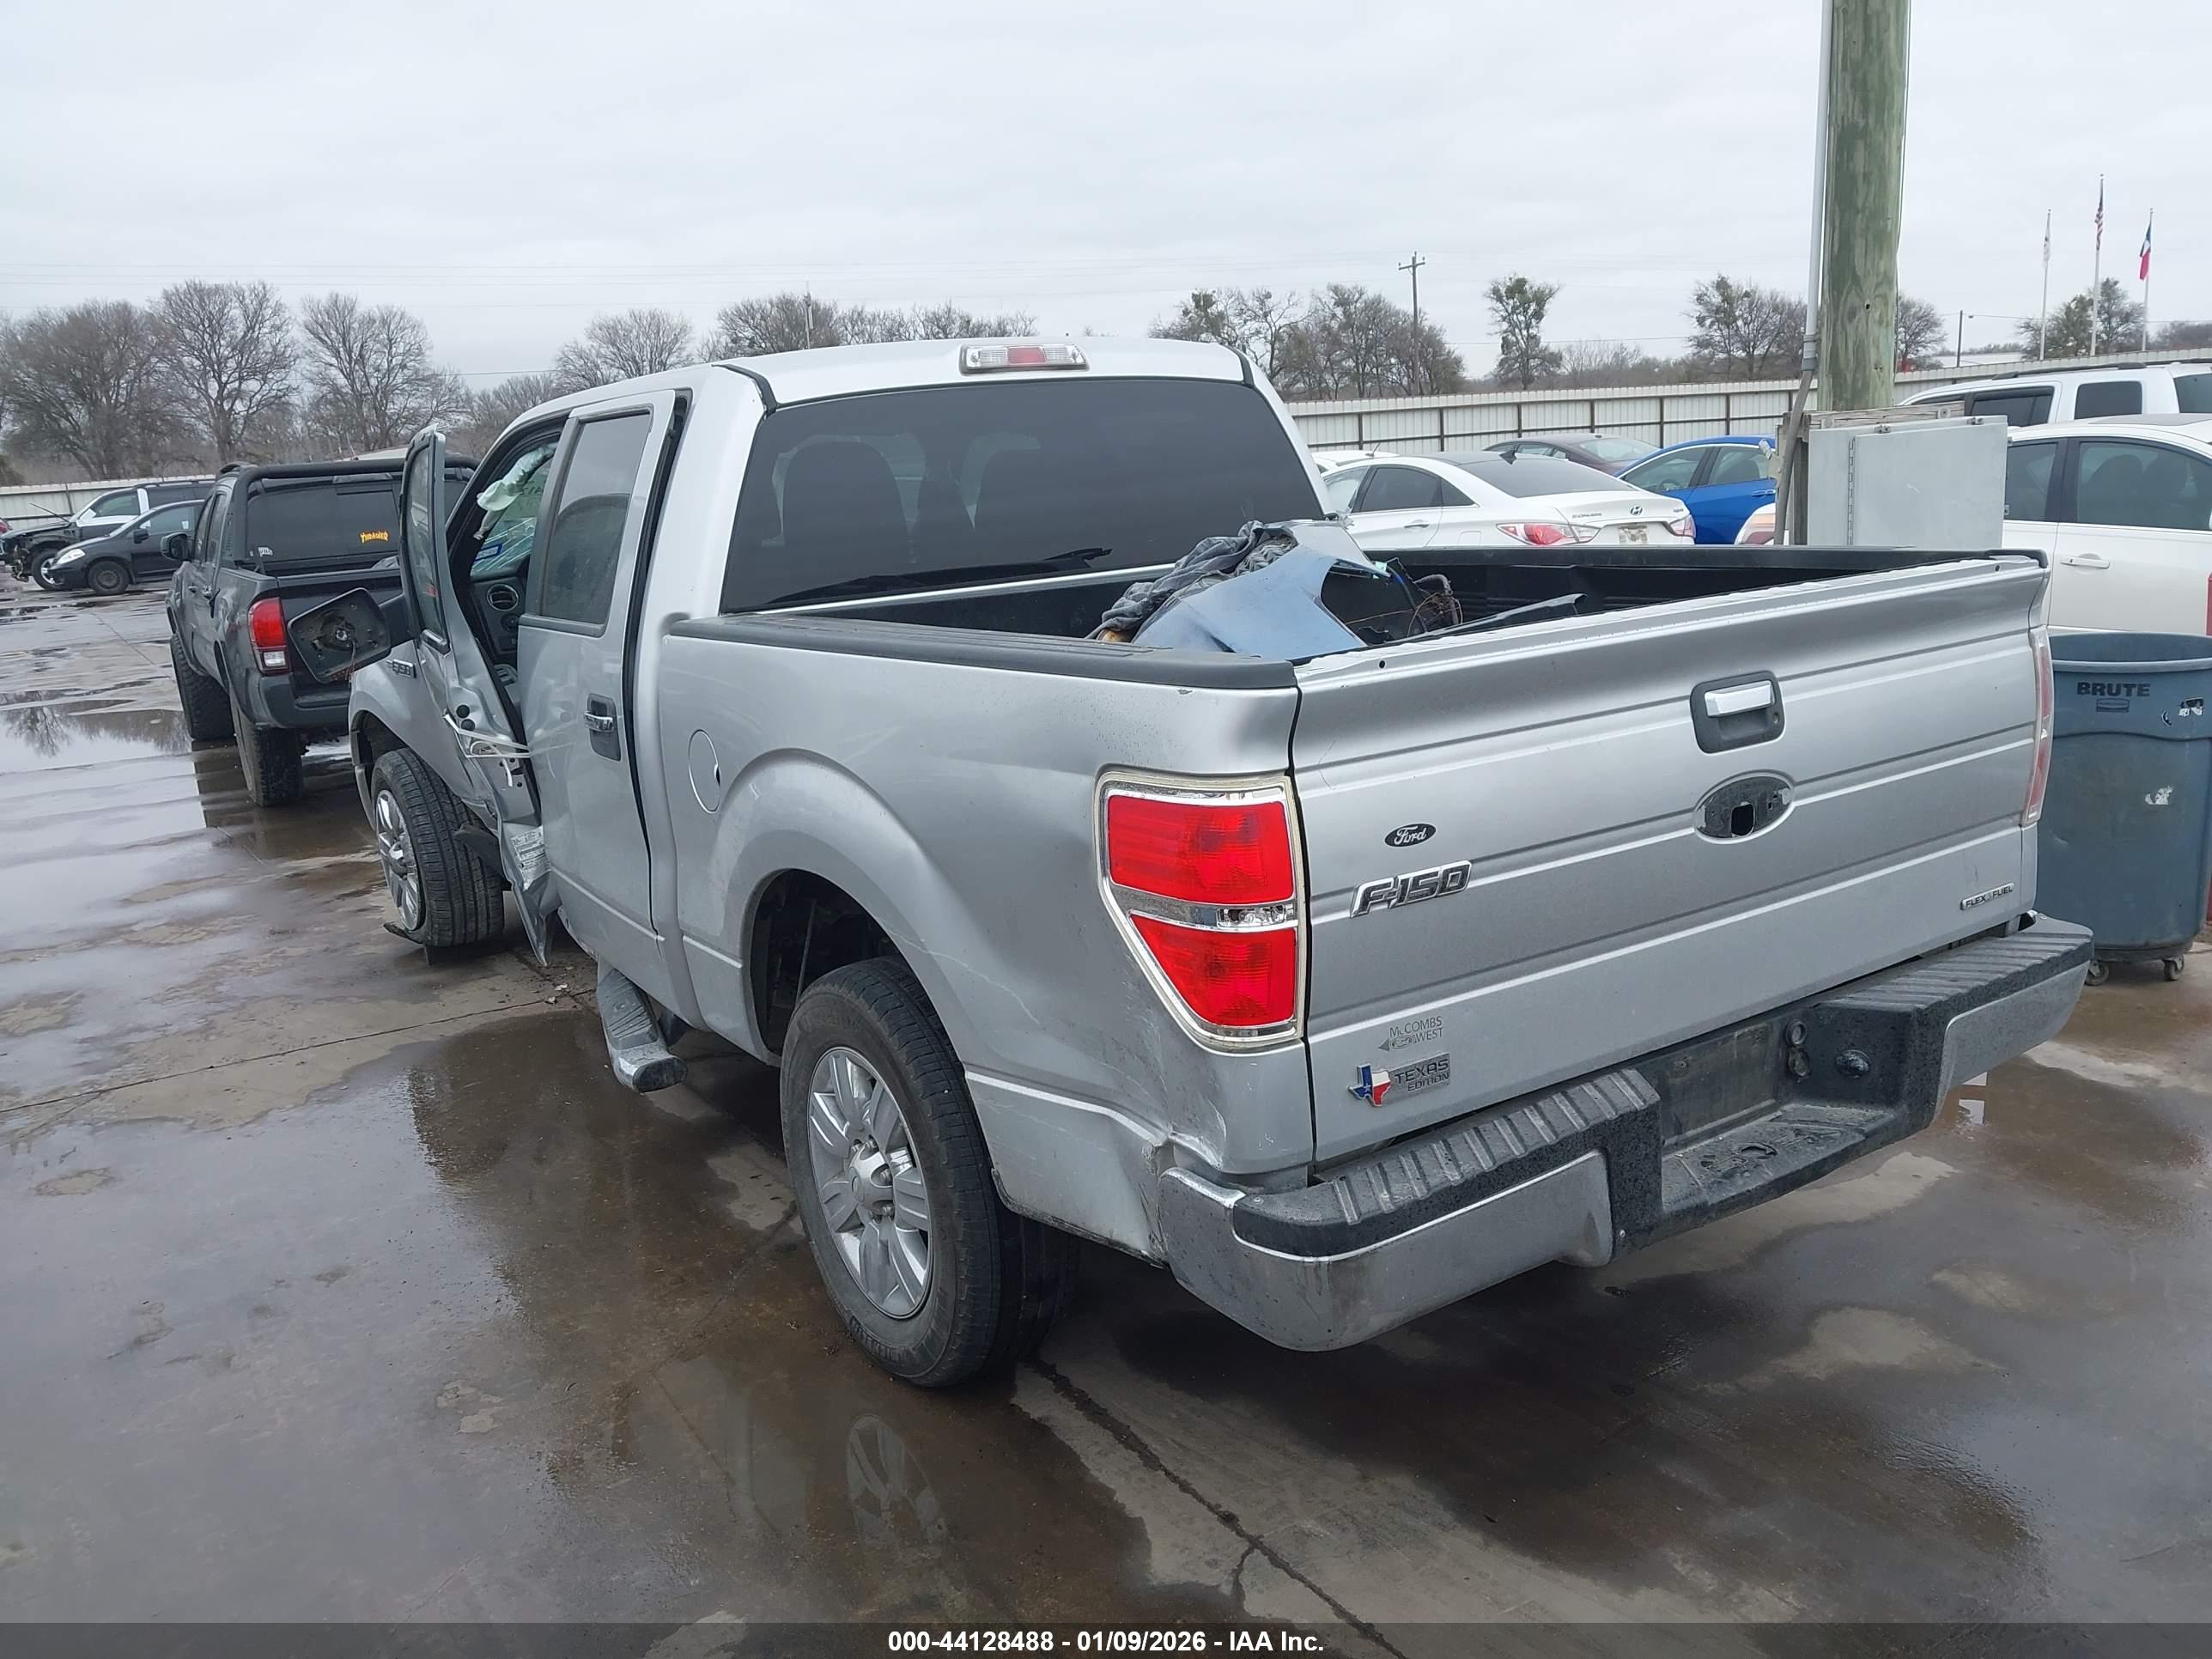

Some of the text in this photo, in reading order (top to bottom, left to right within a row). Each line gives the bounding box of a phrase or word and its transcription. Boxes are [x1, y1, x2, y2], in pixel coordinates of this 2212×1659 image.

[2076, 682, 2151, 697] BRUTE
[1393, 825, 1427, 845] Ford
[1350, 860, 1472, 918] F-150
[1965, 885, 2014, 908] FLEX FUEL
[1414, 1027, 1443, 1043] WEST
[1394, 1058, 1449, 1085] TEXAS
[1407, 1072, 1449, 1093] EDITION
